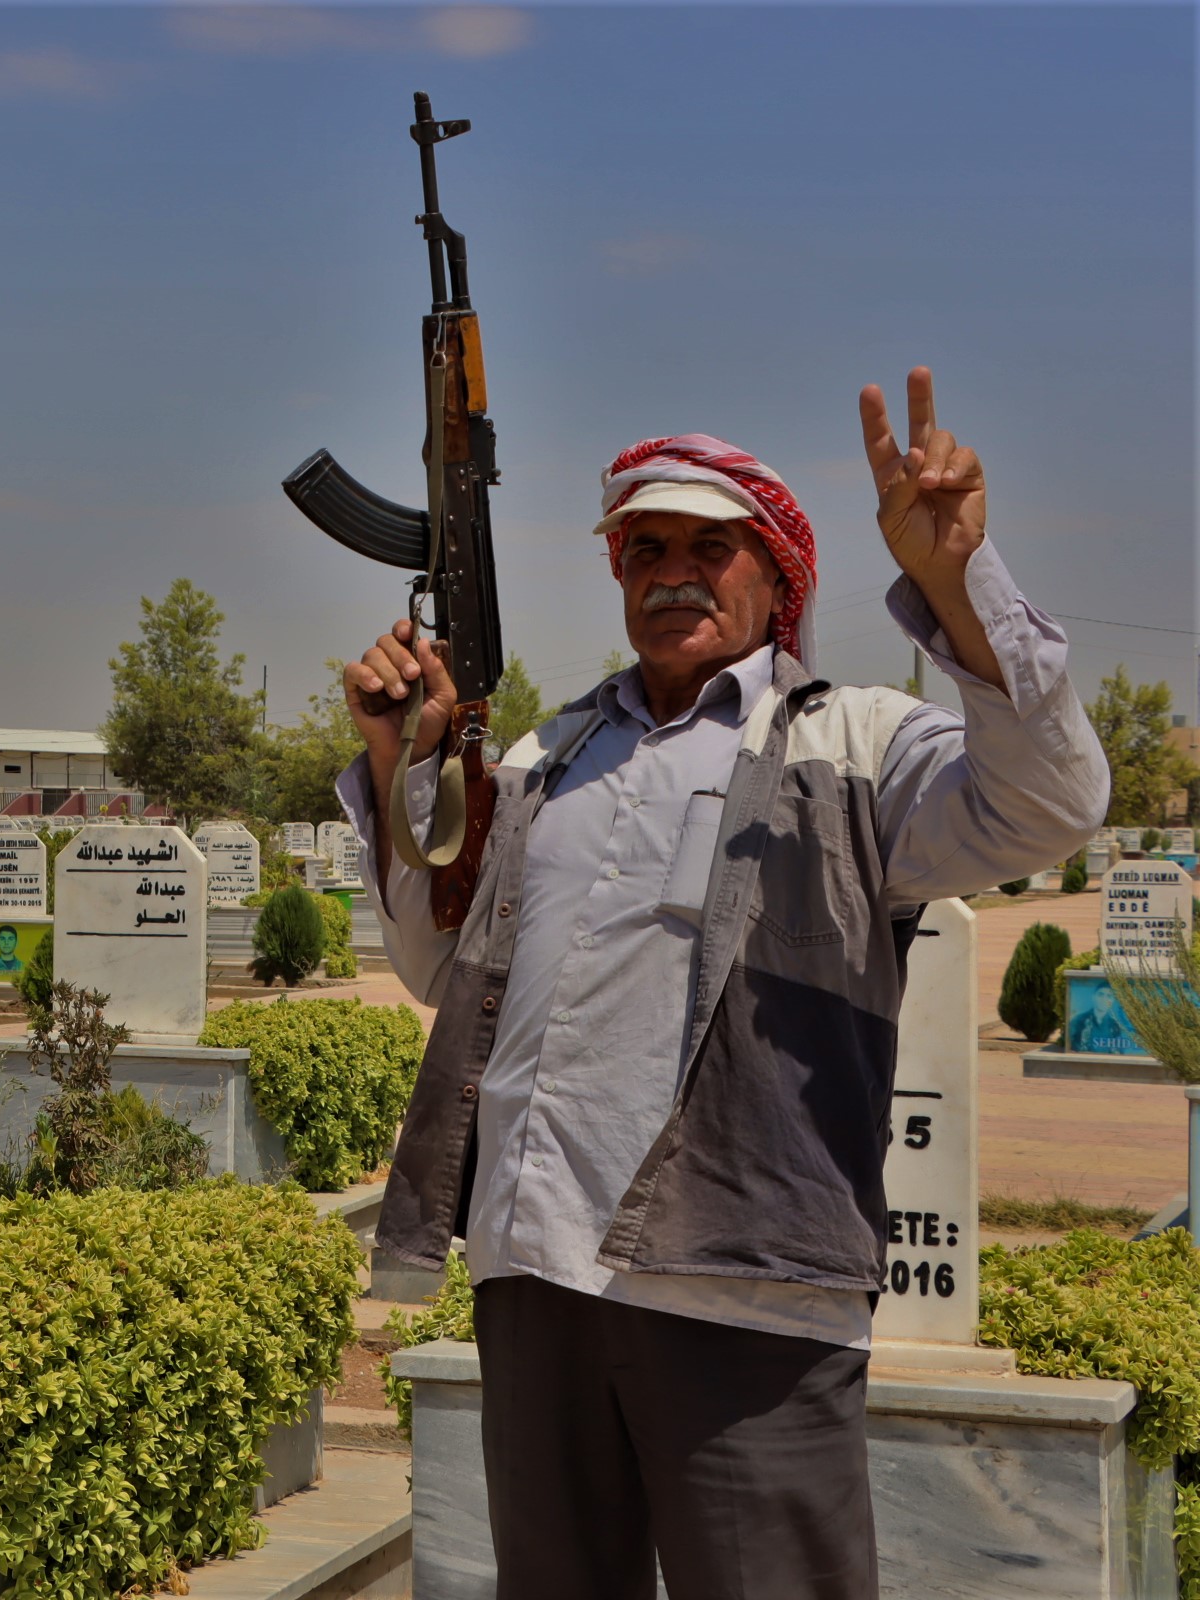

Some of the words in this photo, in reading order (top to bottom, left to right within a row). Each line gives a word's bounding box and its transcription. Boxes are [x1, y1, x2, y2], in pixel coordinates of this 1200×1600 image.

[127, 840, 178, 865] الشهيد
[1108, 889, 1149, 899] LUQMAN
[881, 1260, 955, 1298] 016
